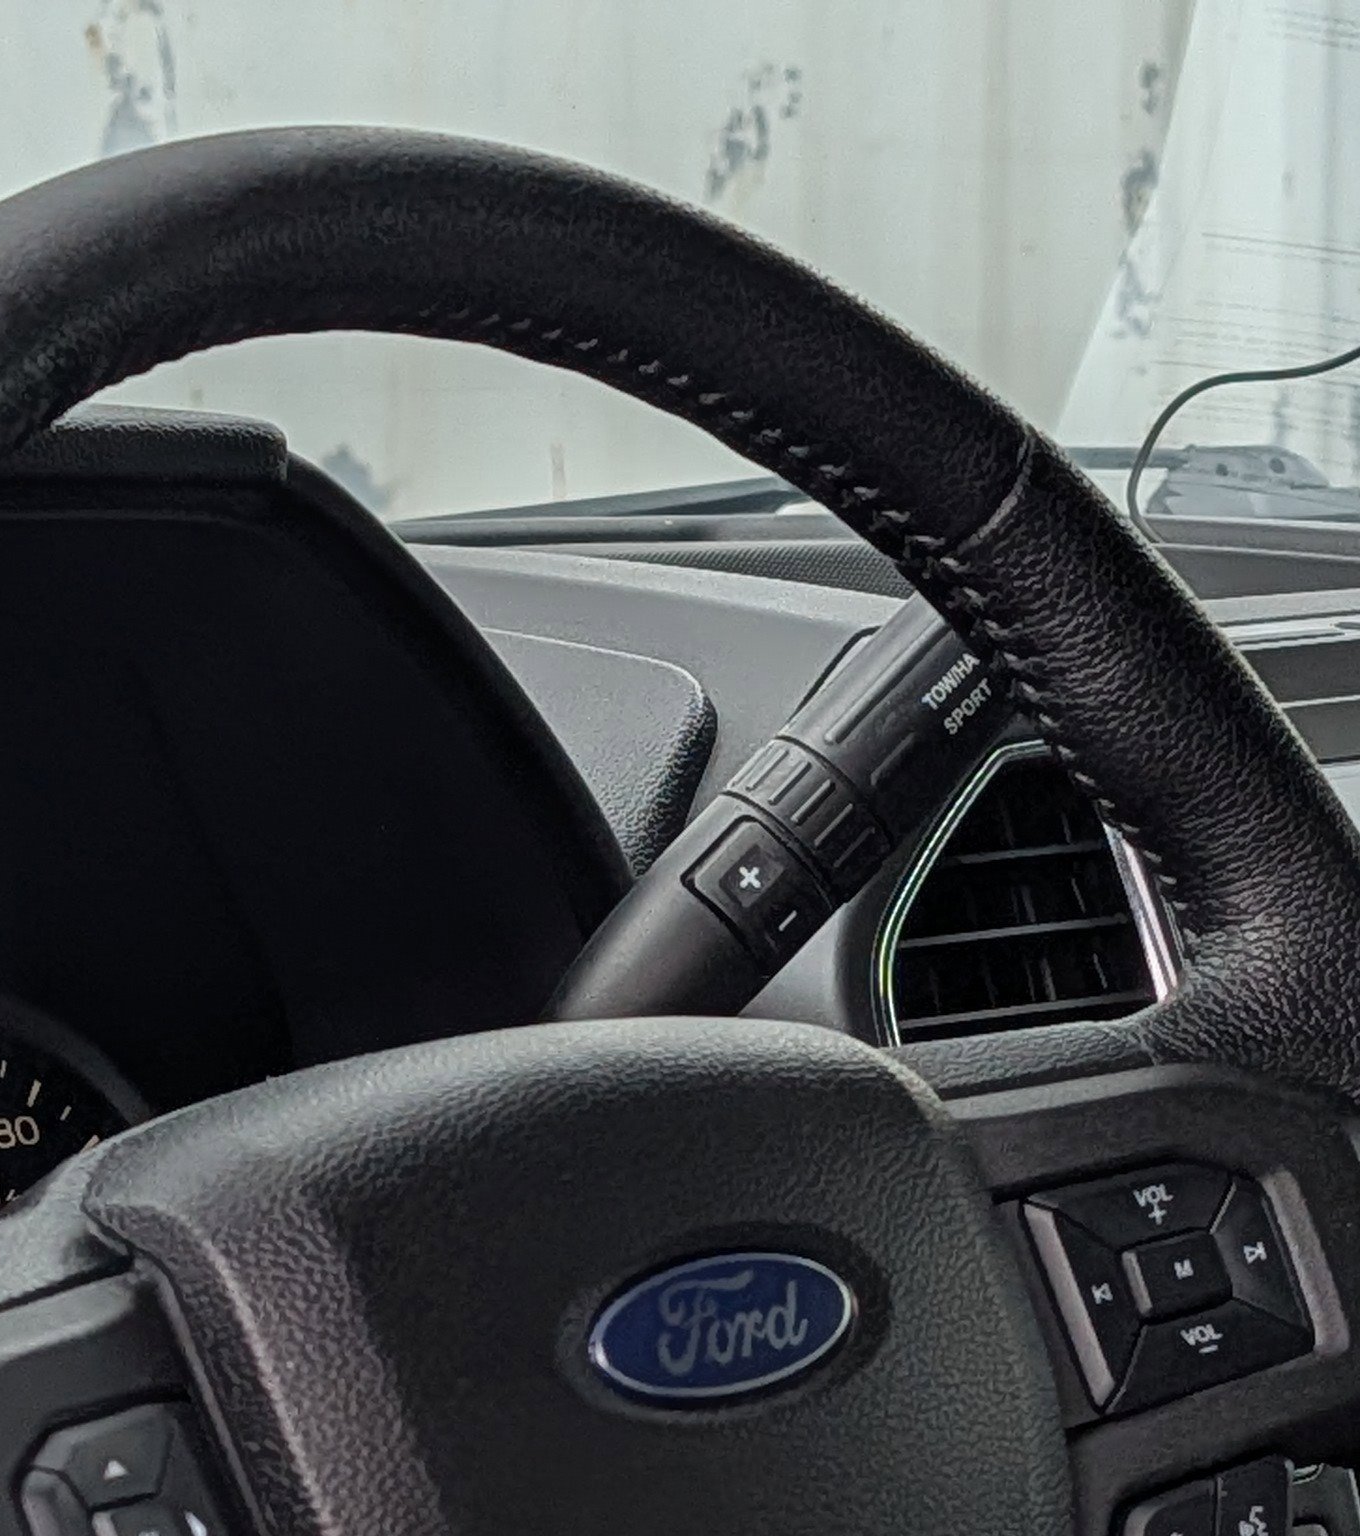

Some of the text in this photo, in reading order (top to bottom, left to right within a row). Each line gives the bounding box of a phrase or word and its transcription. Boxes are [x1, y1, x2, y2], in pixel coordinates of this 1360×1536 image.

[943, 677, 992, 735] SPORT
[1133, 1183, 1175, 1208] VOL
[657, 1269, 809, 1376] Ford
[1179, 1323, 1224, 1346] VOL
